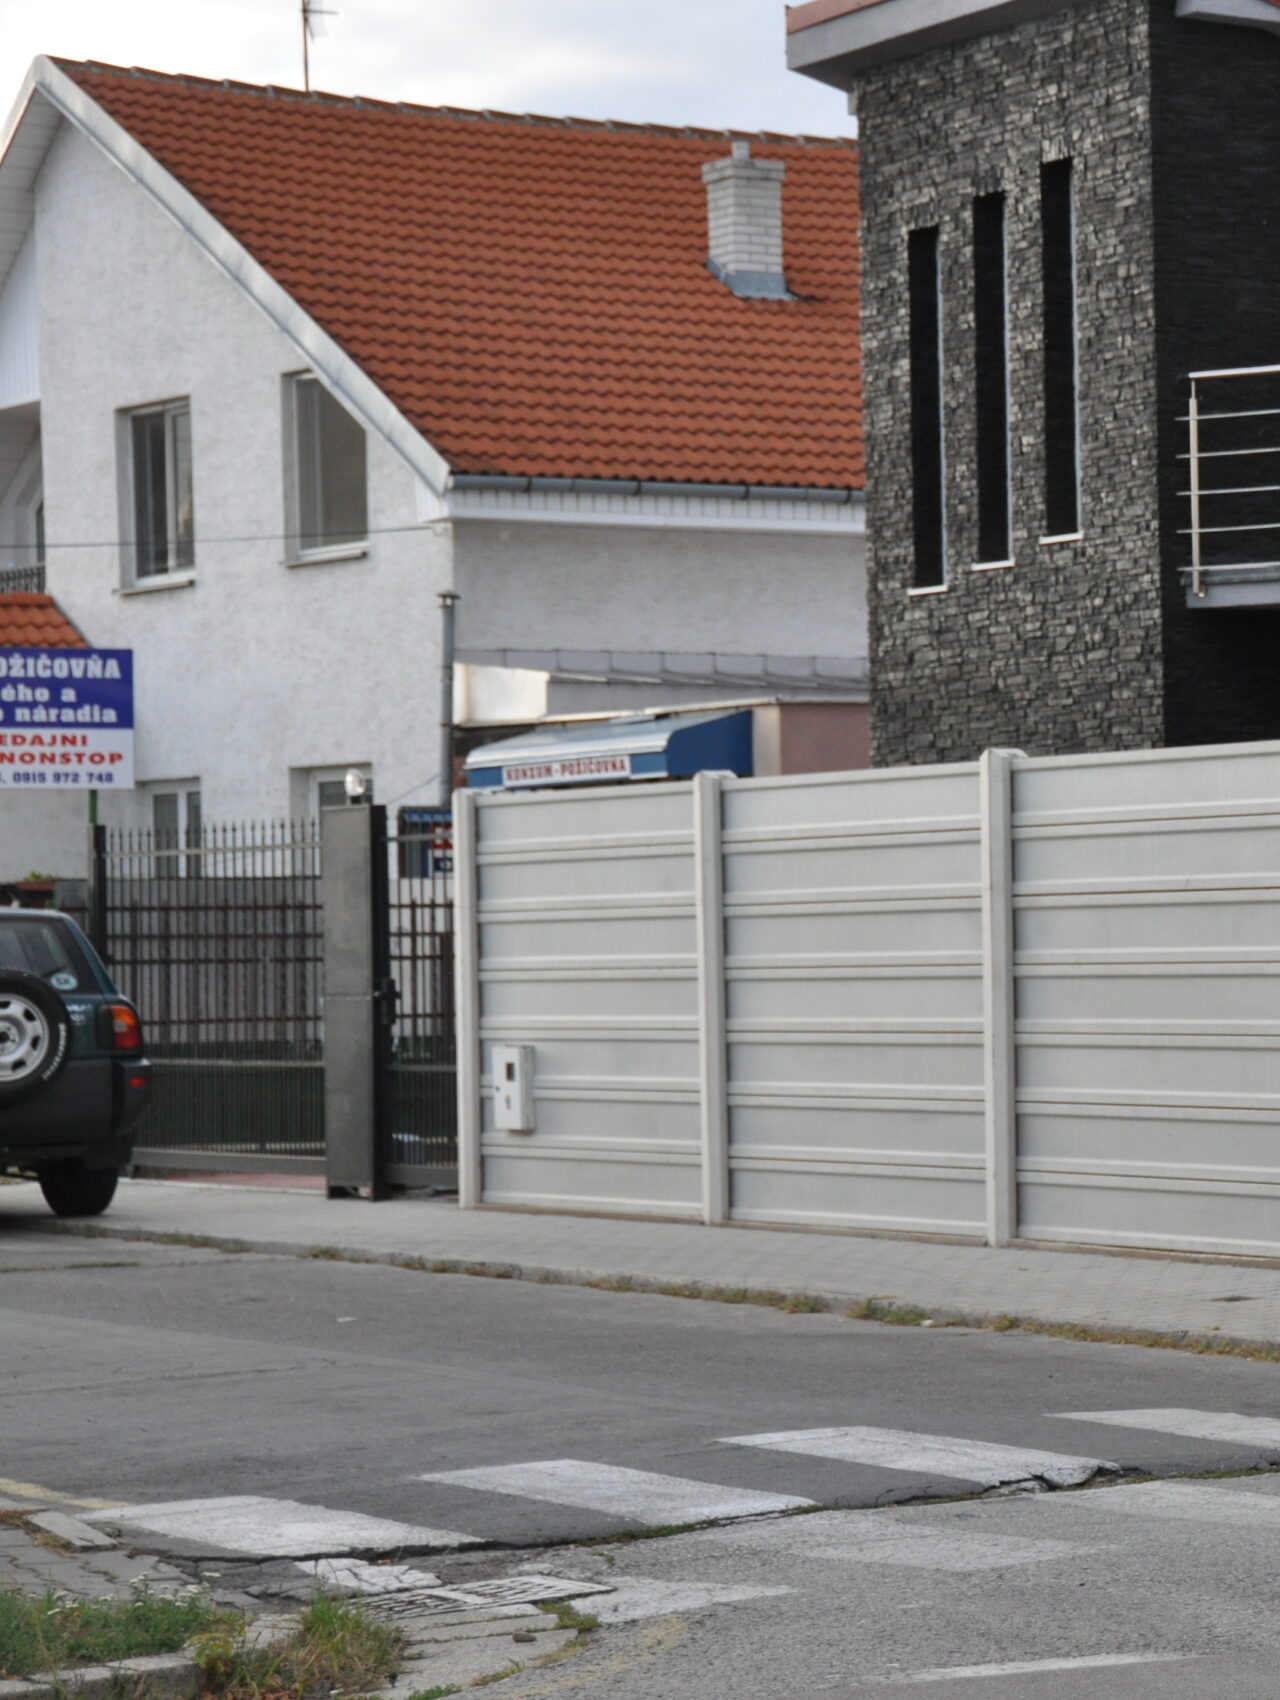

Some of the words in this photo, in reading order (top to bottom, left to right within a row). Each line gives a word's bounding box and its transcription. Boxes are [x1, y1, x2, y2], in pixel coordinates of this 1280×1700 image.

[60, 687, 77, 702] a
[15, 704, 118, 723] náradia
[0, 751, 123, 765] NONSTOP
[13, 771, 46, 784] 0915
